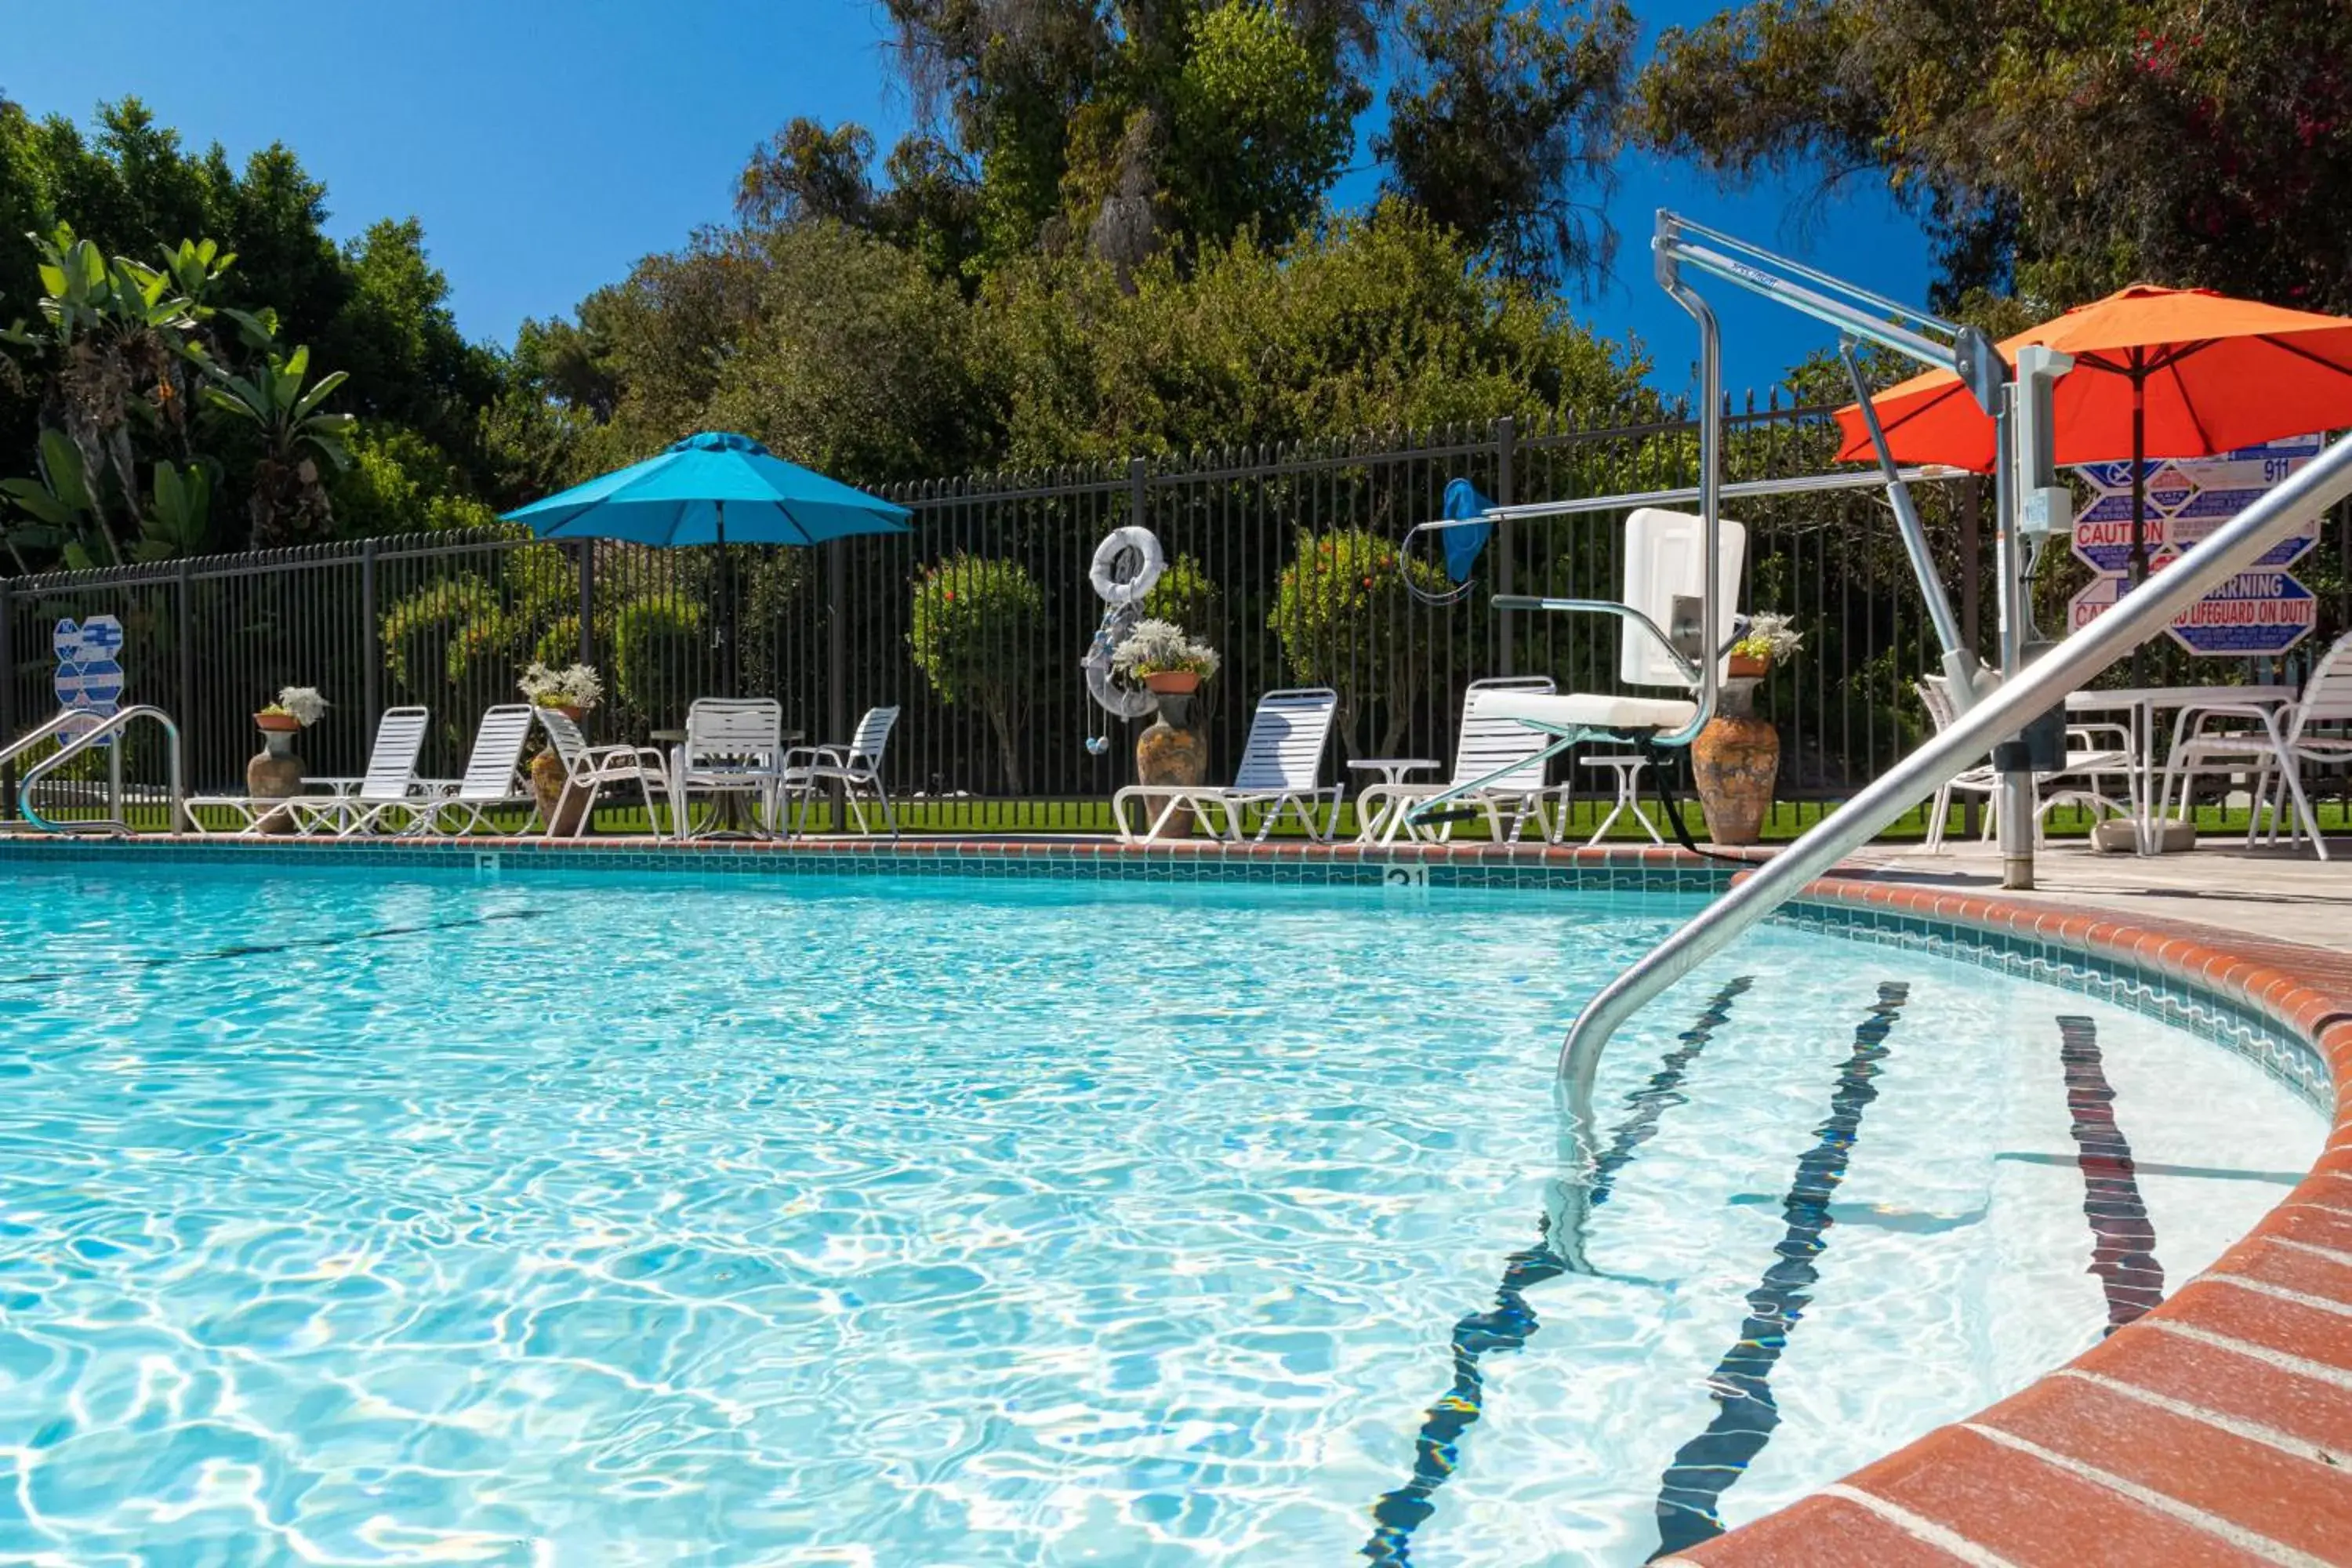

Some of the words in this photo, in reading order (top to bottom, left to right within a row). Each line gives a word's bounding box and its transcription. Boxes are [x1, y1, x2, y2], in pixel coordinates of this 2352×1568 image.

[2264, 459, 2288, 482] 911
[2208, 574, 2283, 597] ARNING
[2190, 601, 2255, 625] LIFEGUARD
[2259, 601, 2277, 623] ON
[2281, 600, 2314, 623] DUTY
